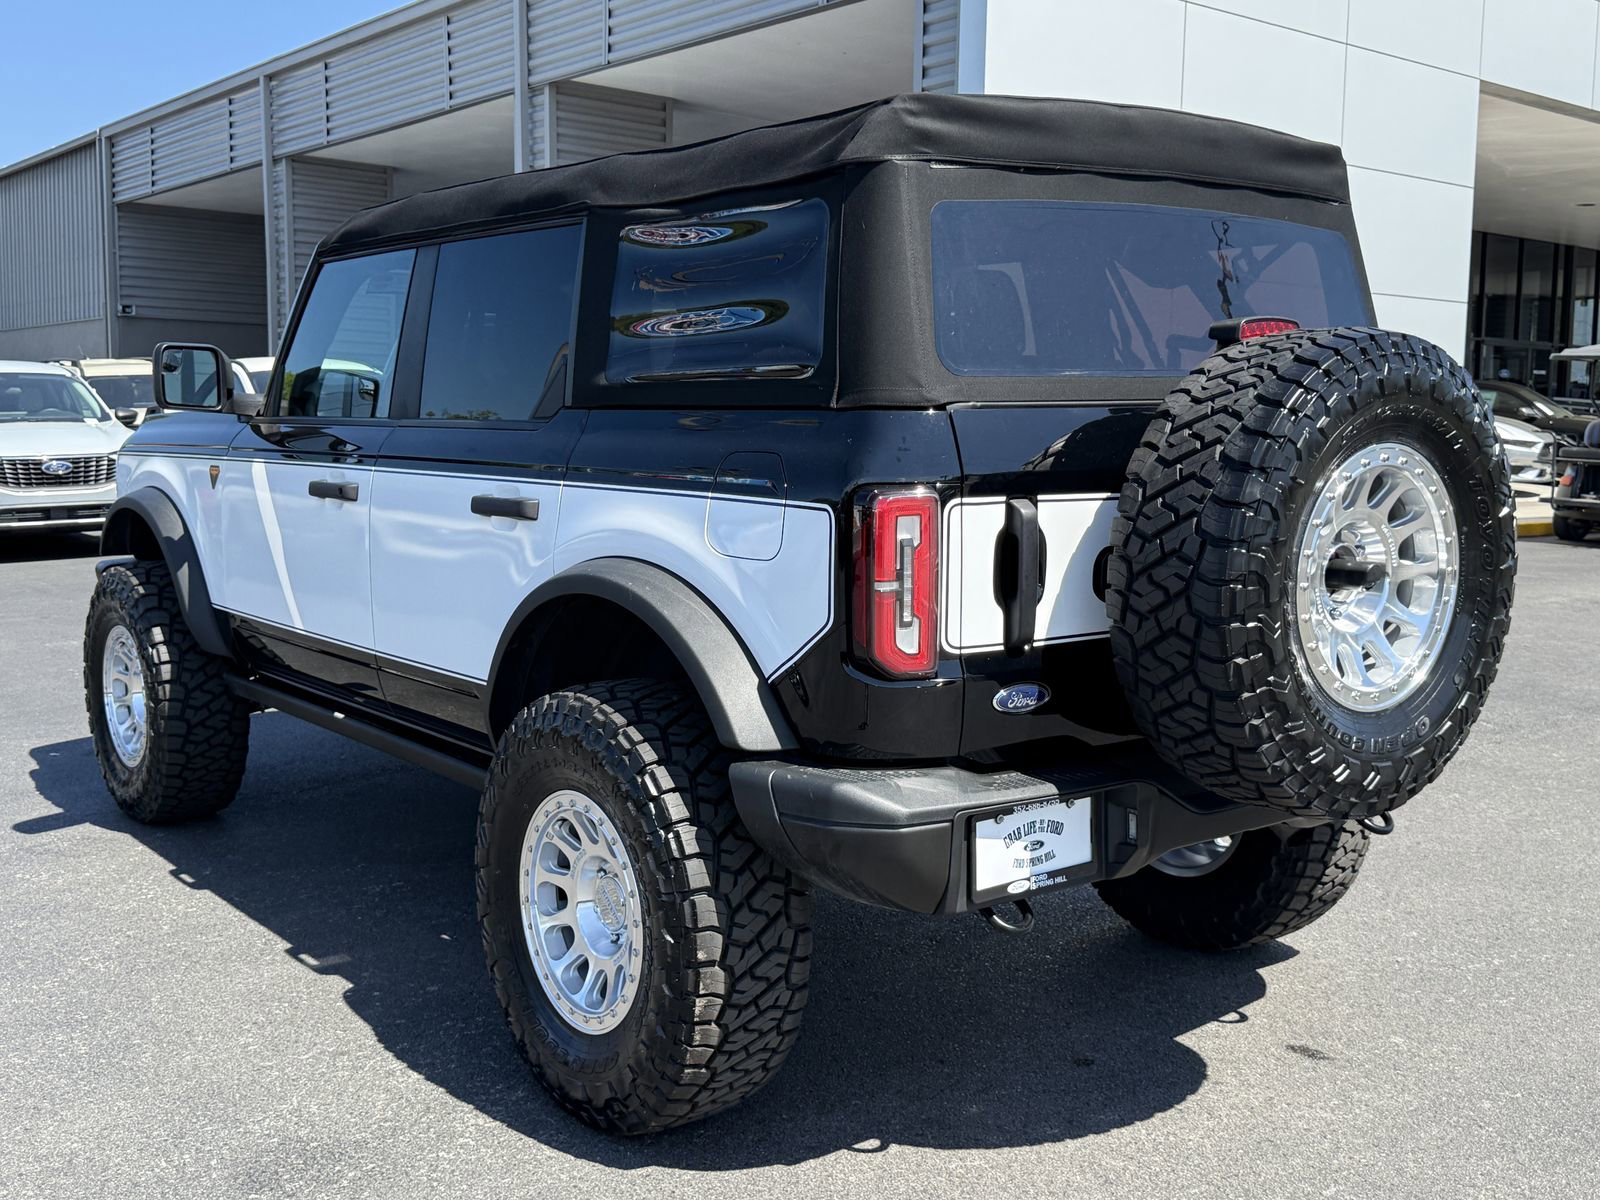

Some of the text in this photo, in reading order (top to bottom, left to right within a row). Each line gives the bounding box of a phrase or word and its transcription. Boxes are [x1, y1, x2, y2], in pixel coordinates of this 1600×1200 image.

[1468, 473, 1497, 572] TOYO
[1007, 691, 1038, 708] Ford
[1370, 715, 1430, 754] OPEN
[1003, 827, 1023, 849] GRAB
[1023, 820, 1037, 837] LIFE
[1046, 820, 1064, 836] FORD
[1026, 855, 1043, 868] SPRING
[1044, 850, 1056, 862] HILL
[1054, 875, 1068, 884] HILL
